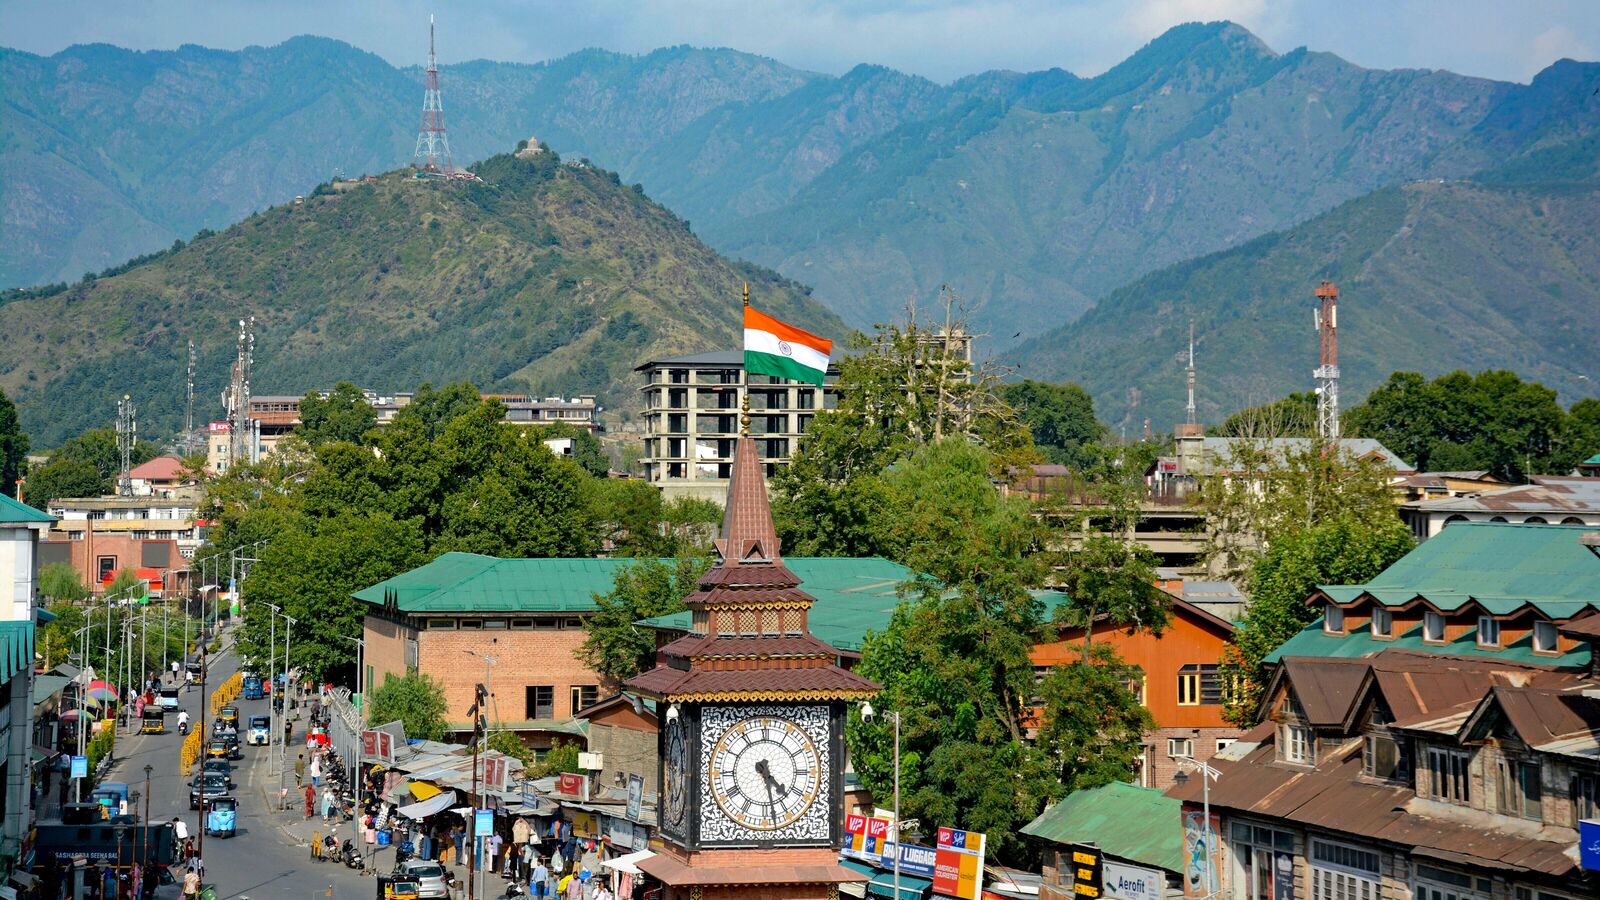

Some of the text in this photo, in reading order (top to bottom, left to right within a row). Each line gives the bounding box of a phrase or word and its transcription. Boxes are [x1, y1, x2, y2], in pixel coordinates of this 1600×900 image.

[849, 816, 864, 831] VIP
[871, 820, 885, 835] VIP
[940, 831, 950, 842] VIP
[883, 843, 904, 860] BHT
[904, 846, 937, 866] LUGGAGE
[935, 870, 958, 881] TOURISTER
[936, 864, 959, 874] AMERICAN
[1118, 875, 1145, 894] Aerofit
